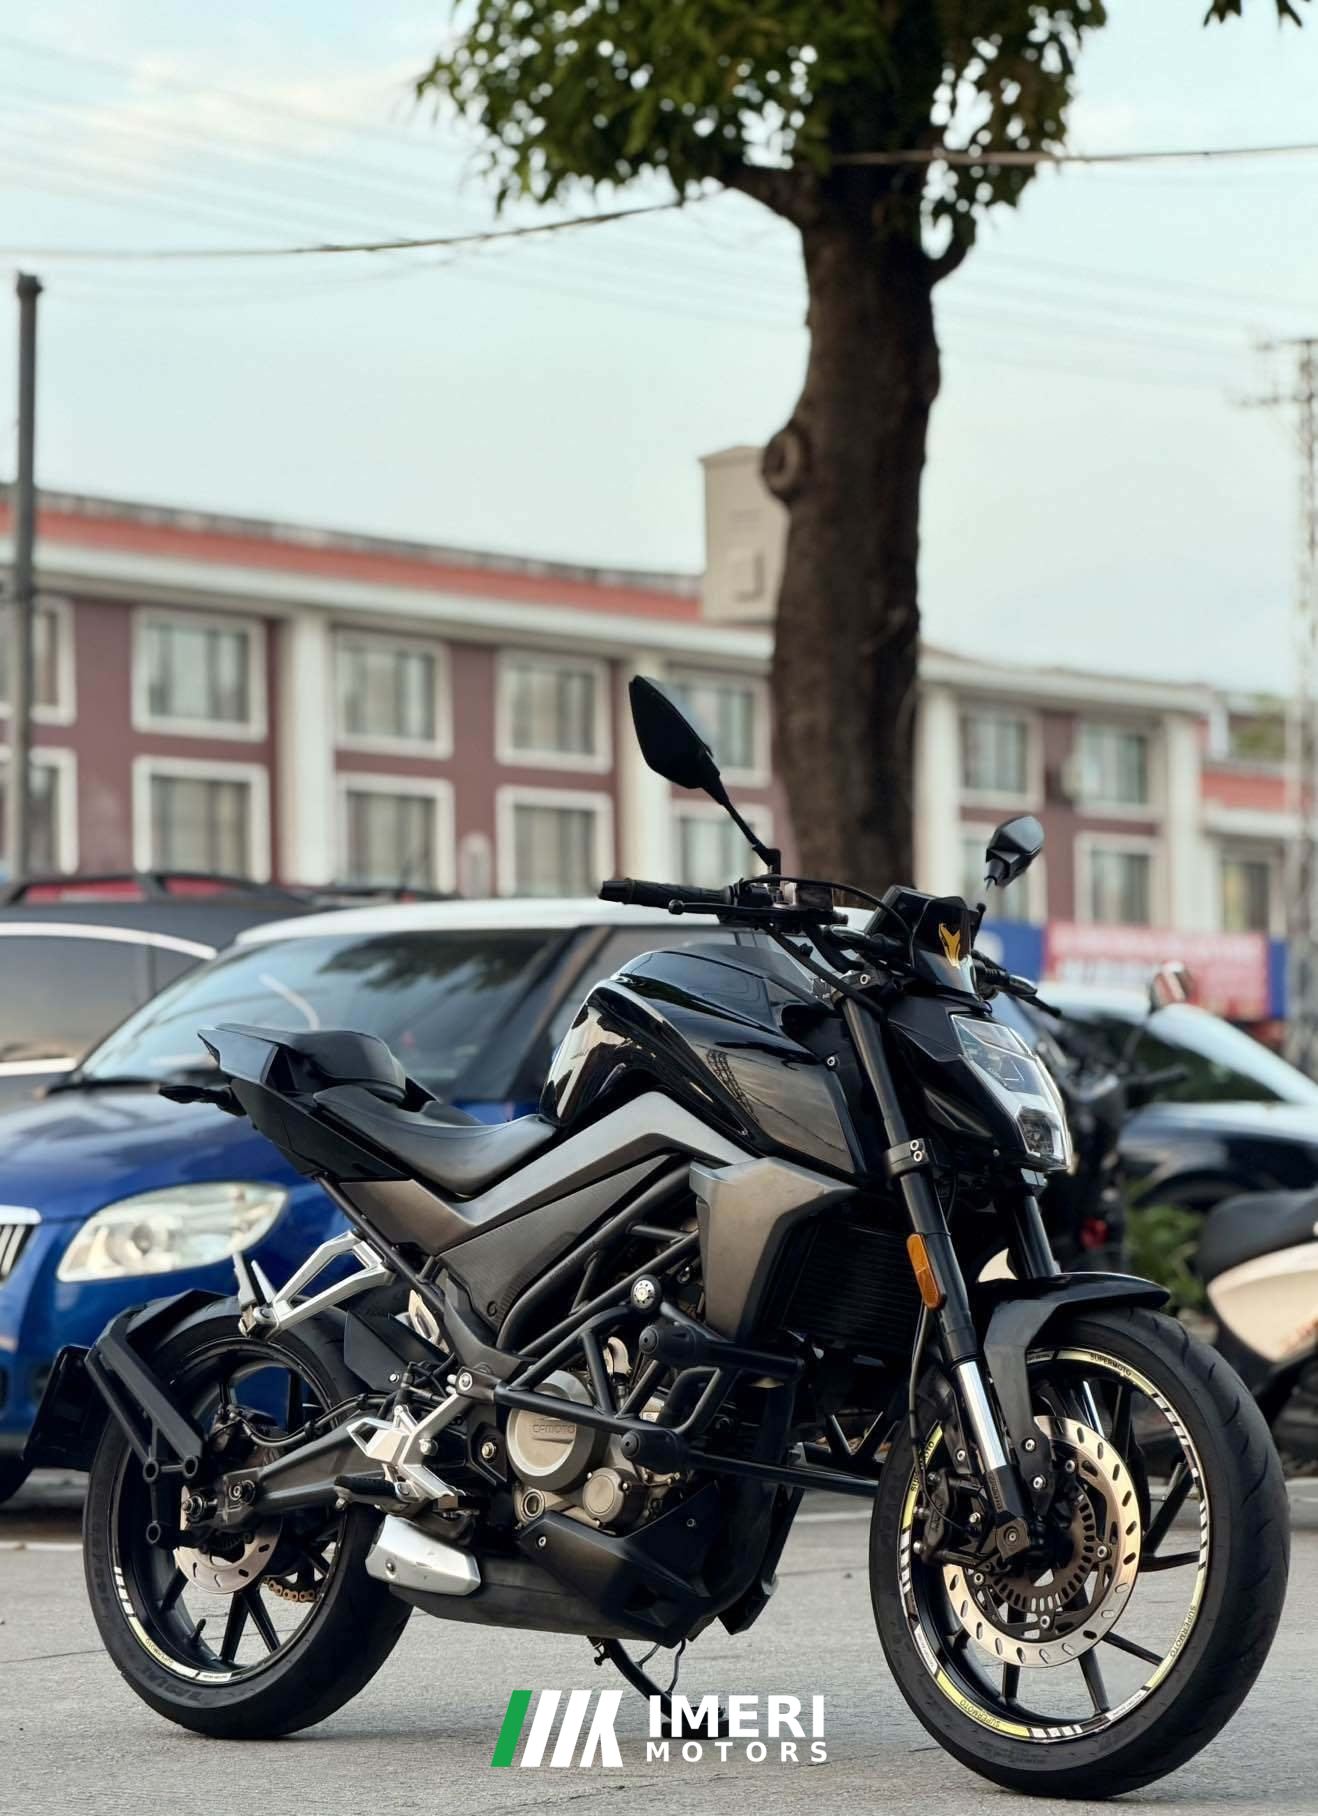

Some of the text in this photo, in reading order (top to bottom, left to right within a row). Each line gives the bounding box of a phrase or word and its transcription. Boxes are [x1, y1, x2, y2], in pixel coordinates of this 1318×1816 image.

[1089, 1352, 1132, 1376] SUPERMOTO
[1170, 1605, 1197, 1658] SUPERMOTO
[960, 1699, 1001, 1728] SUPERMOTO
